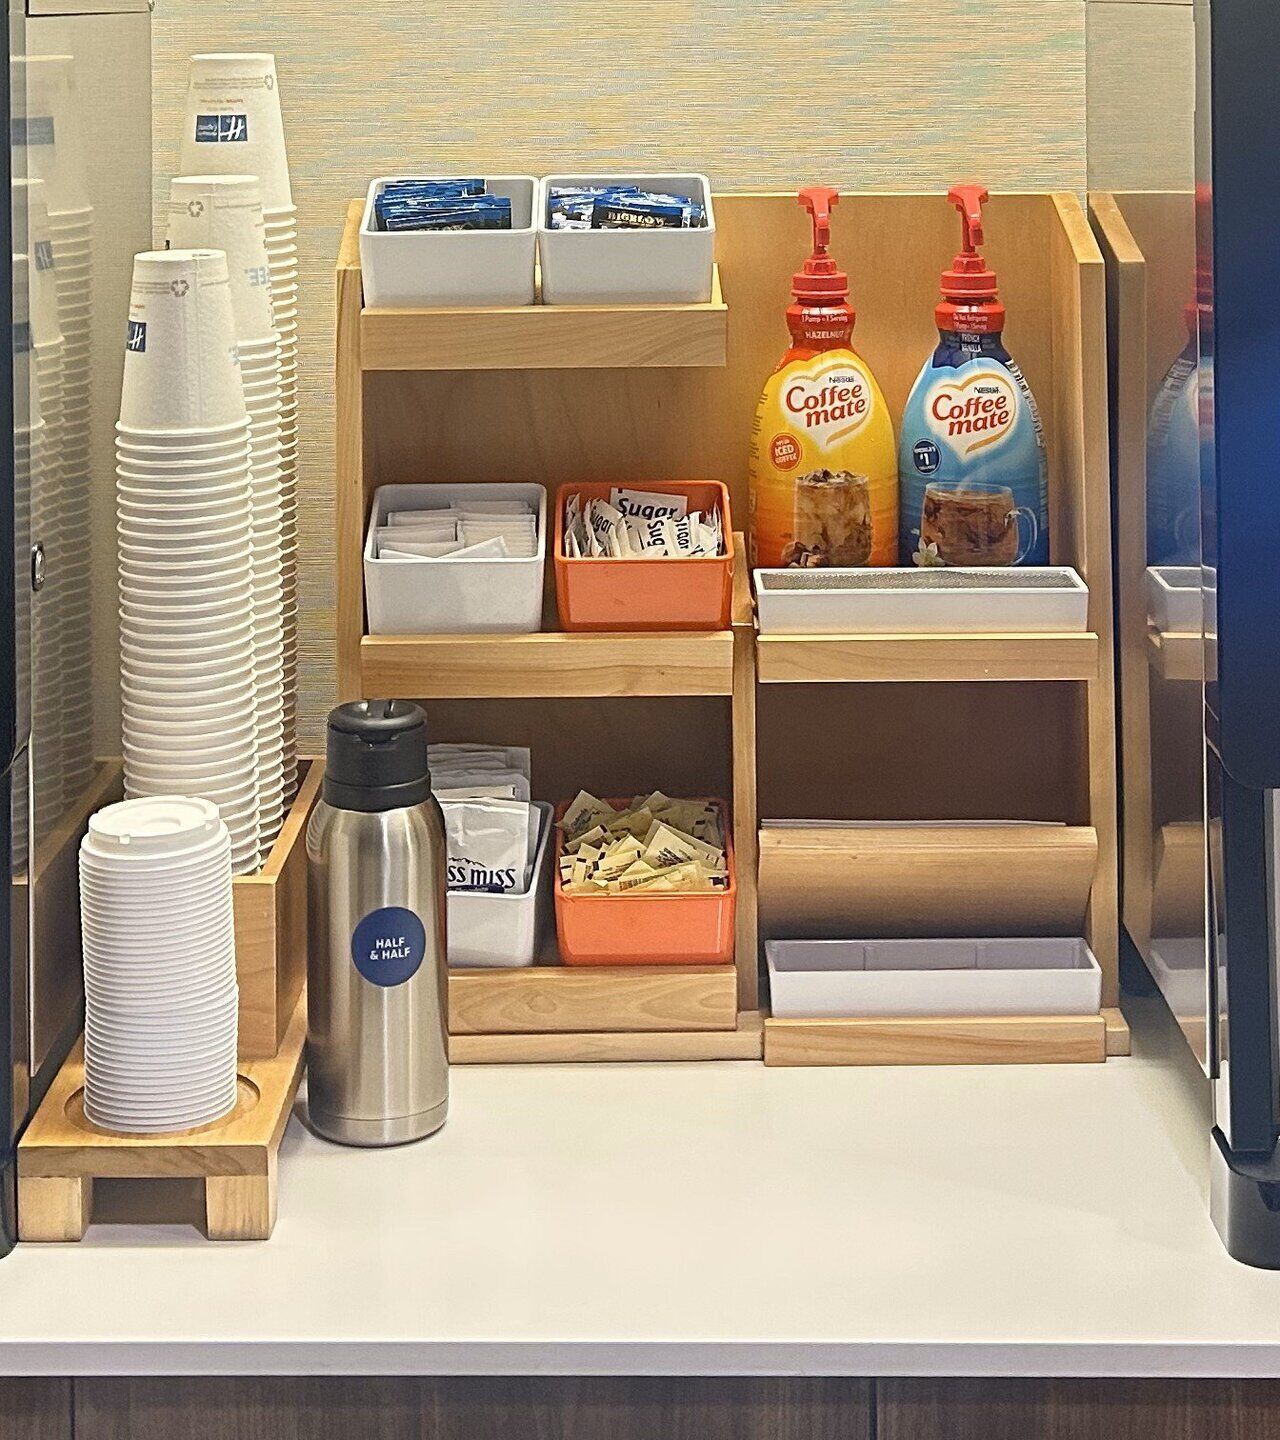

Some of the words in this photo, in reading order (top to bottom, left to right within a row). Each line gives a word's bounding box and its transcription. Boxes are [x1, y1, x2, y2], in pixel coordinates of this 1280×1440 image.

[786, 384, 863, 413] Coffee
[932, 394, 1007, 421] Coffee
[806, 398, 866, 428] mate
[948, 410, 1010, 436] mate
[592, 506, 615, 534] ugar
[618, 497, 679, 521] Sugar
[646, 519, 665, 548] Sug
[370, 950, 379, 960] &
[382, 947, 411, 960] HALF
[375, 936, 406, 949] HALF
